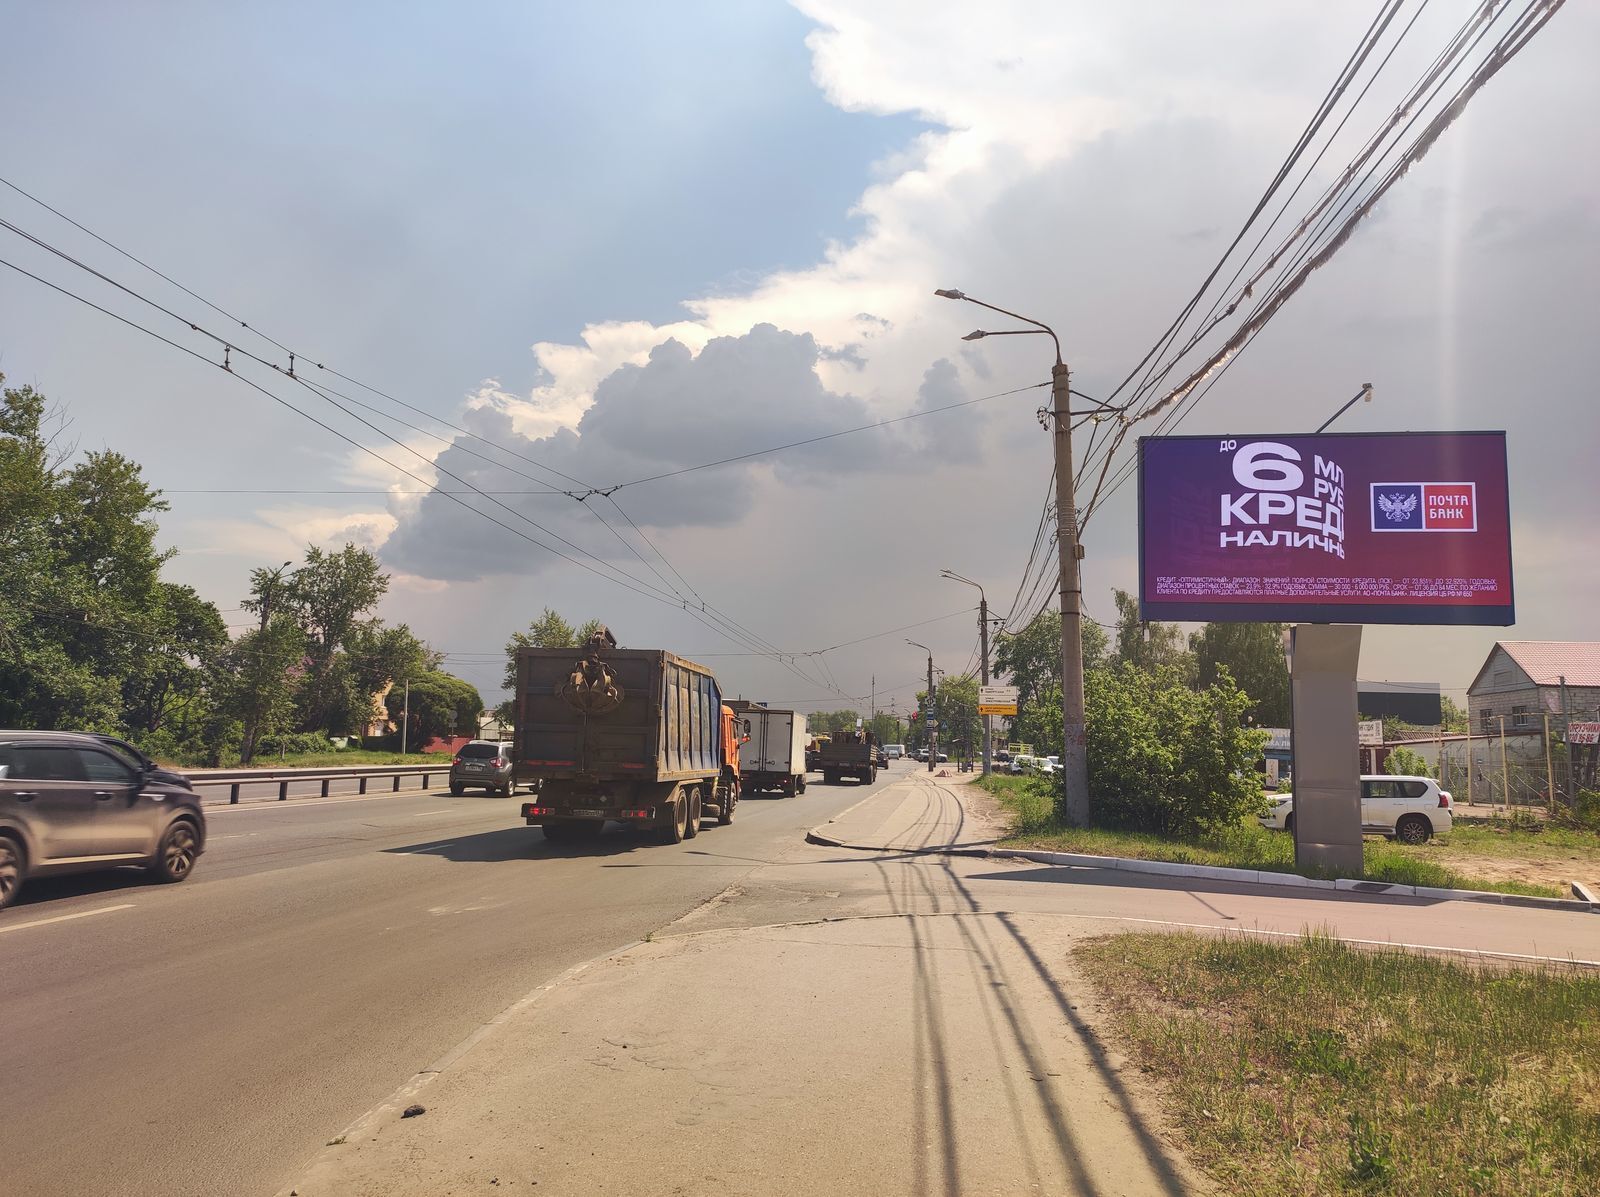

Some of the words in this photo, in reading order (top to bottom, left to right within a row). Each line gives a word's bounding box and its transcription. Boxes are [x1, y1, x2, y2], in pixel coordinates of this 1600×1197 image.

[1219, 440, 1237, 453] ДО
[1232, 441, 1304, 492] 6
[1429, 495, 1469, 506] ПОЧТА
[1429, 508, 1464, 519] БАНК
